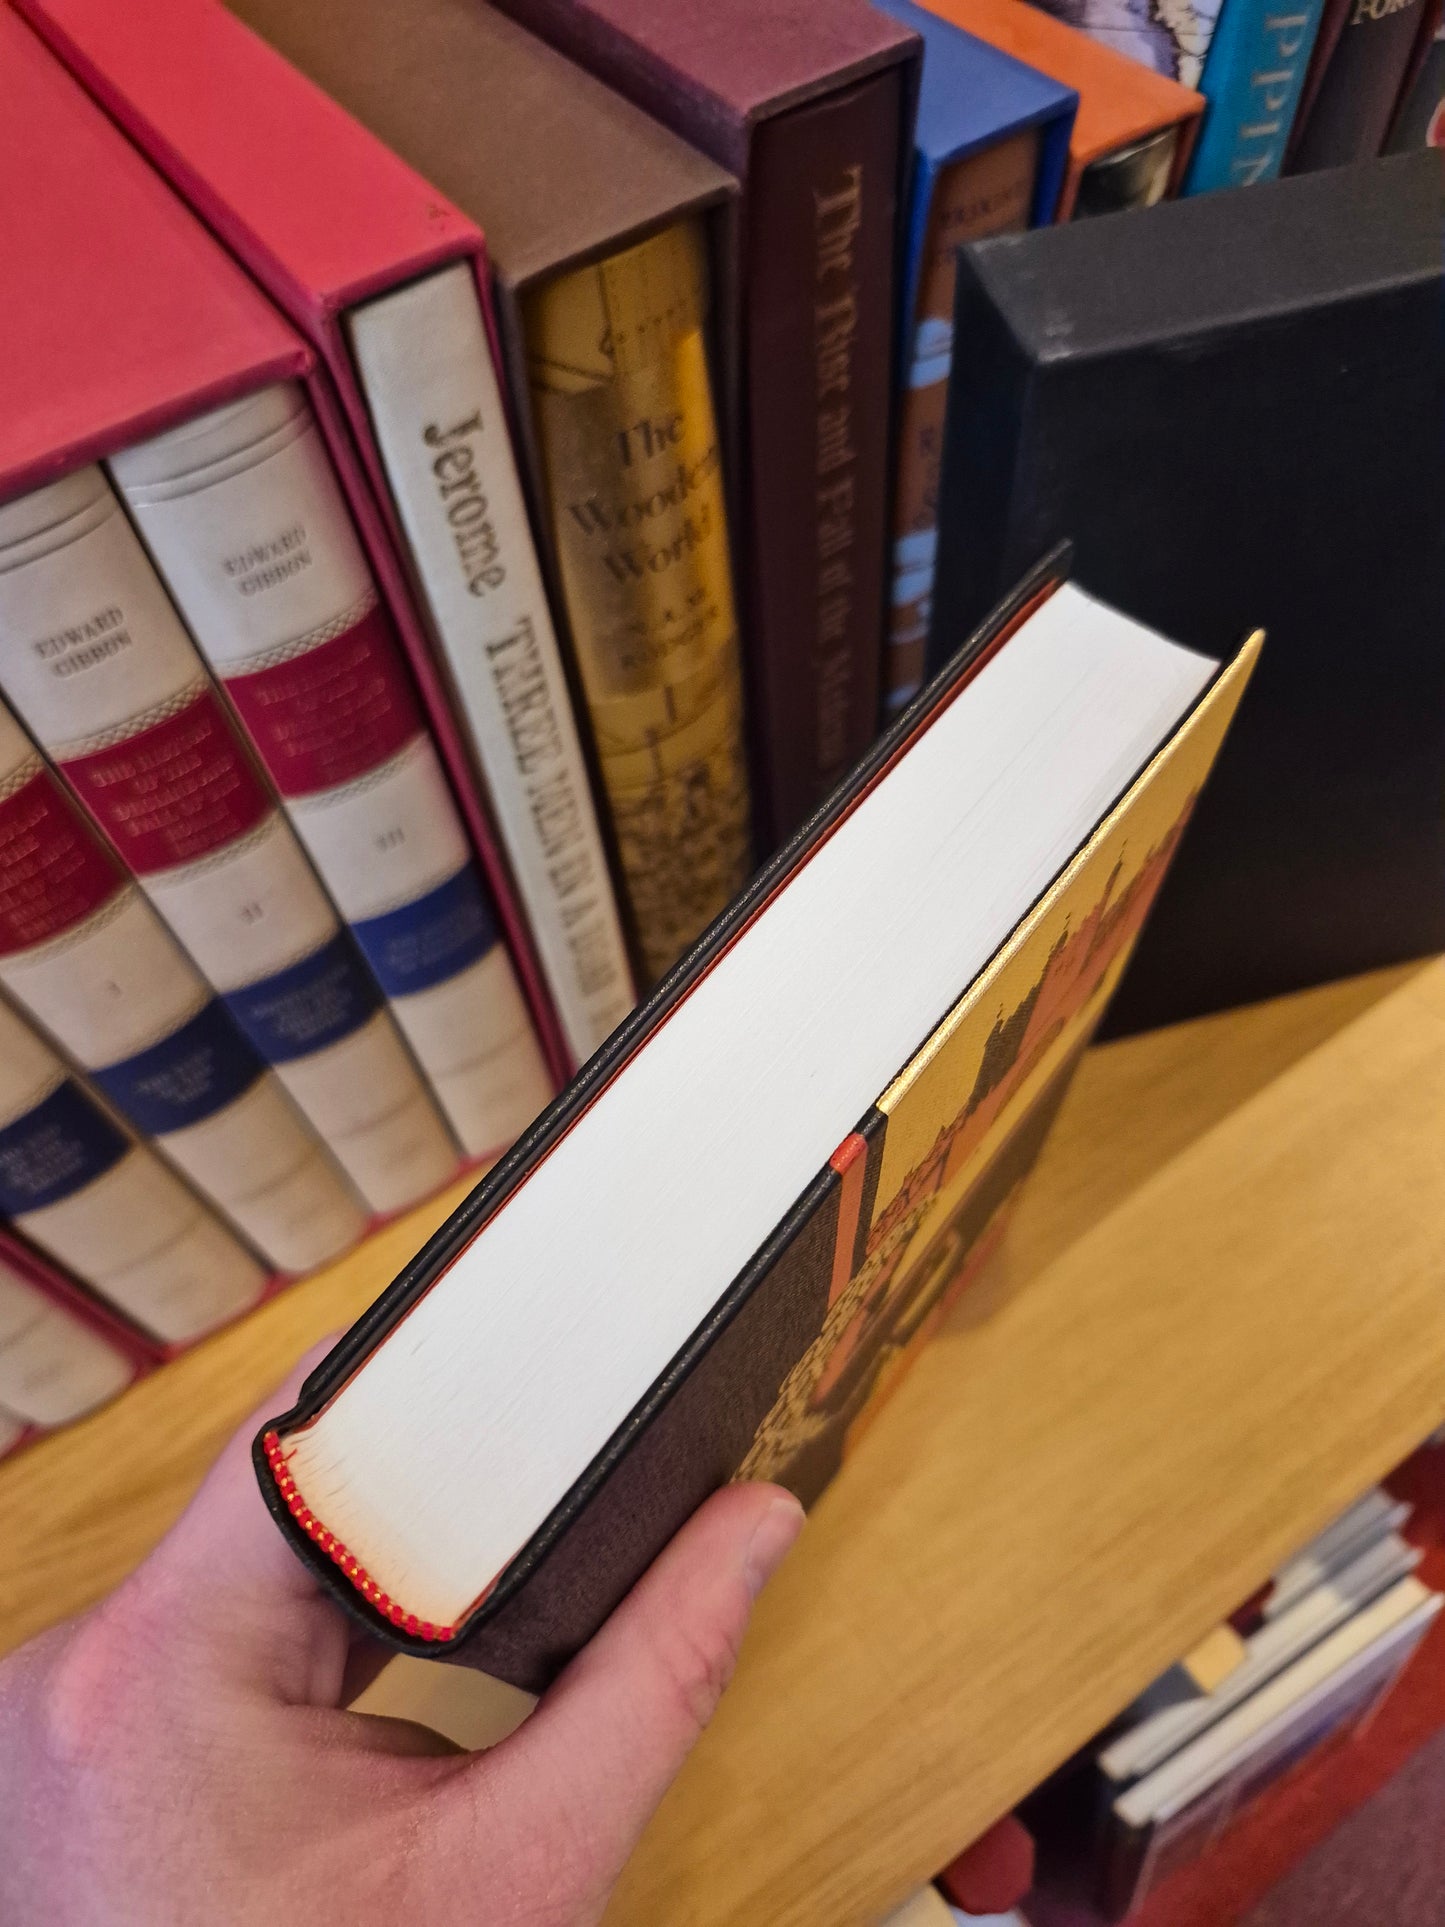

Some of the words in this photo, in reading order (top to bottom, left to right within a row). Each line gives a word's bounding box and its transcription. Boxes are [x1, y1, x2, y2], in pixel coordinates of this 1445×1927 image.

[813, 165, 861, 281] The
[617, 411, 685, 467] The
[222, 524, 307, 578] EDWARD
[239, 551, 313, 597] GIBBON
[423, 409, 507, 598] Jerome
[484, 614, 564, 776] THREE
[34, 607, 124, 660] EDWARD
[52, 630, 132, 679] GIBBON
